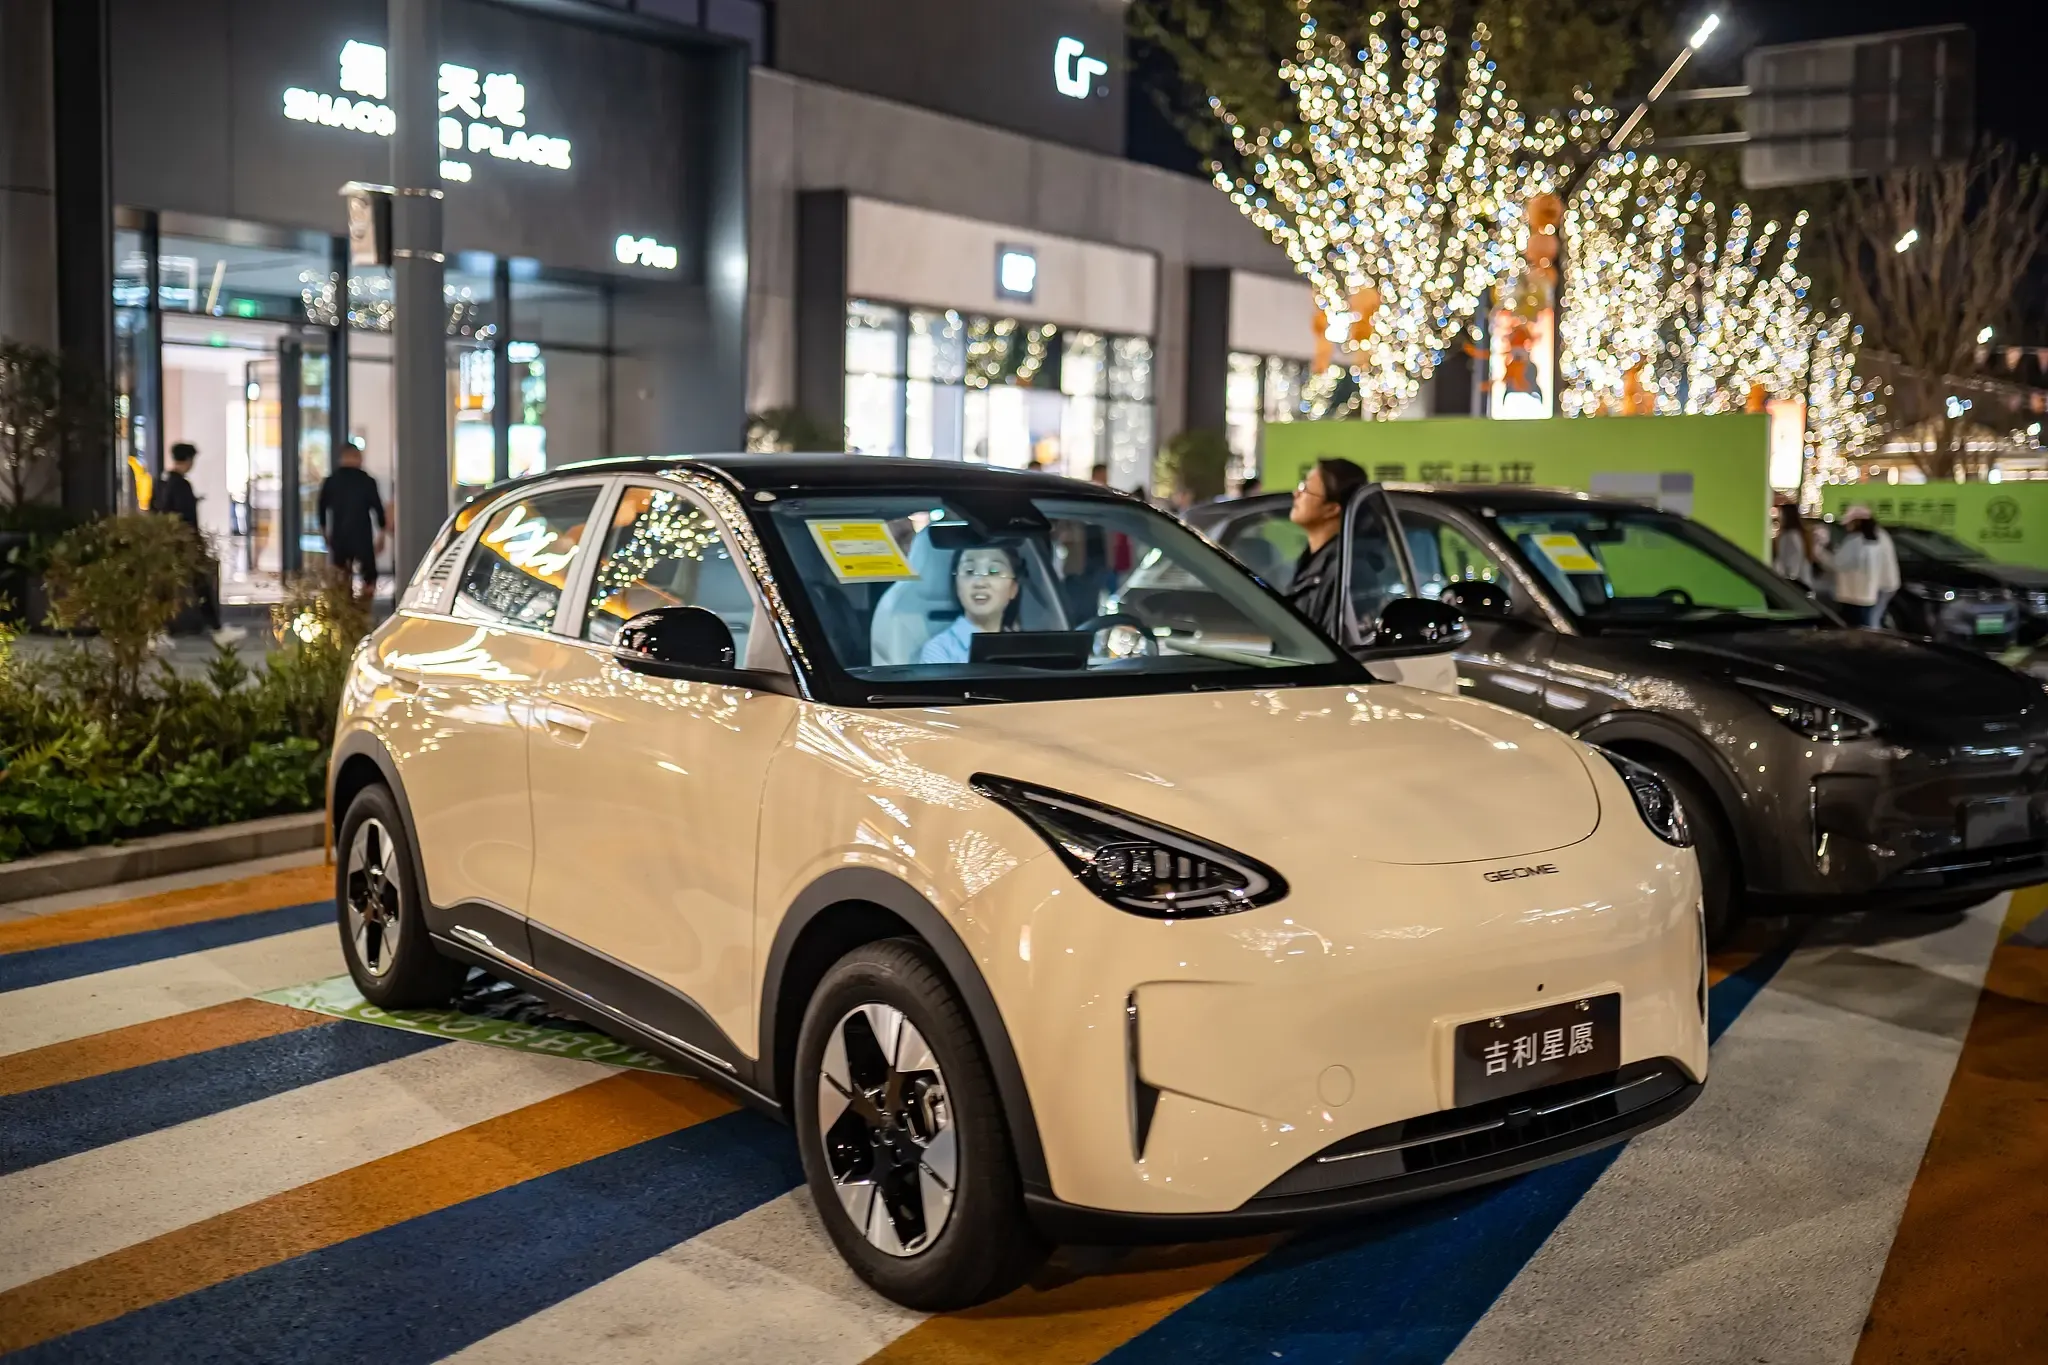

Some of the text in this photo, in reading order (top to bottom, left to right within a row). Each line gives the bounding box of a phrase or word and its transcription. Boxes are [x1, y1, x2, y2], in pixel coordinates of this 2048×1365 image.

[1483, 863, 1560, 883] GEOME
[1483, 1021, 1595, 1077] 吉利星愿
